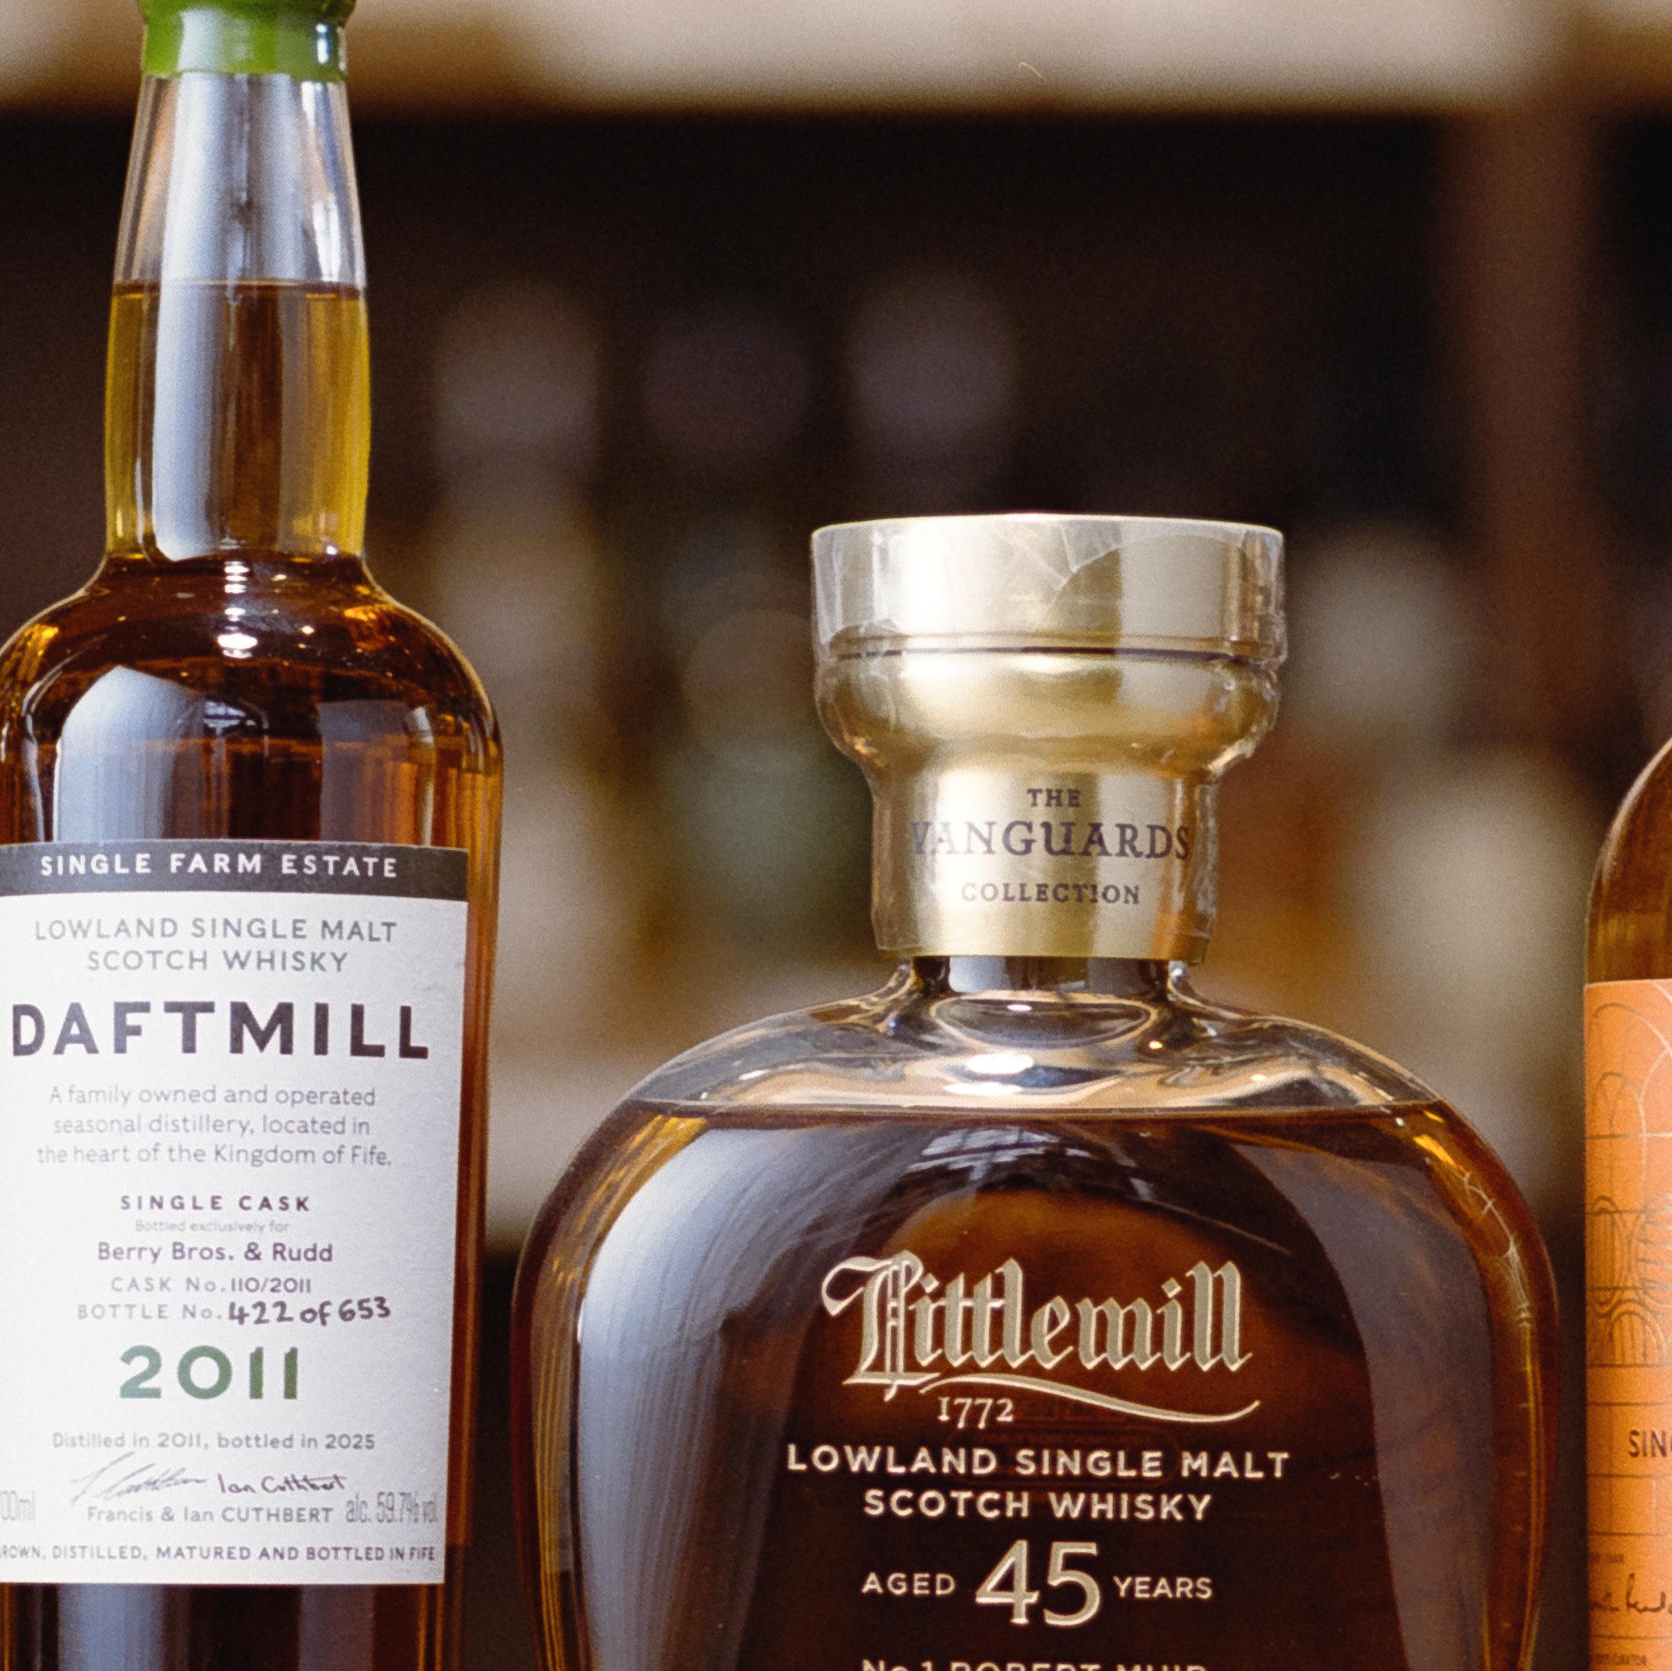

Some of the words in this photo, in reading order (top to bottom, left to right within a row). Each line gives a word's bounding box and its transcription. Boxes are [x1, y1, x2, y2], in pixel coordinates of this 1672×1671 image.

[1027, 788, 1081, 808] THE
[909, 821, 1190, 860] VANGUARDS
[41, 854, 151, 876] SINGLE
[171, 854, 261, 874] FARM
[282, 855, 397, 877] ESTATE
[962, 883, 1139, 905] COLLECTION
[35, 918, 178, 941] LOWLAND
[191, 918, 306, 939] SINGLE
[320, 921, 397, 942] MALT
[88, 951, 207, 971] SCOTCH
[223, 951, 348, 972] WHISKY
[12, 1001, 429, 1059] DAFTMILL
[49, 1086, 62, 1104] A
[67, 1085, 131, 1108] family
[138, 1085, 217, 1104] owned
[224, 1085, 268, 1104] and
[275, 1087, 376, 1111] operated
[54, 1116, 144, 1135] seasonal
[148, 1115, 255, 1139] distillery,
[262, 1116, 346, 1135] located
[352, 1117, 370, 1135] in
[38, 1146, 69, 1164] the
[73, 1145, 131, 1164] heart
[137, 1144, 161, 1162] of
[165, 1144, 207, 1162] the
[213, 1144, 316, 1168] Kingdom
[322, 1145, 346, 1164] of
[351, 1146, 392, 1166] Fife.
[120, 1195, 223, 1211] SINGLE
[239, 1195, 311, 1212] CASK
[98, 1242, 161, 1263] Berry
[172, 1242, 234, 1262] Bros.
[244, 1243, 262, 1262] &
[272, 1243, 333, 1263] Rudd
[111, 1277, 173, 1293] CASK
[185, 1277, 226, 1293] No.
[230, 1277, 311, 1294] 110/2011
[77, 1304, 169, 1320] BOTTLE
[182, 1304, 222, 1320] No.
[228, 1300, 293, 1325] 422
[299, 1302, 333, 1326] of
[338, 1296, 391, 1322] 653
[821, 1250, 1253, 1401] Littlemill
[119, 1345, 299, 1400] 2011
[937, 1397, 1015, 1428] 1772
[53, 1433, 126, 1450] Distilled
[132, 1432, 150, 1449] in
[158, 1432, 209, 1451] 2011,
[217, 1432, 293, 1450] bottled
[300, 1433, 319, 1450] in
[787, 1444, 997, 1474] LOWLAND
[1015, 1449, 1163, 1478] SINGLE
[1181, 1451, 1289, 1479] MALT
[87, 1506, 154, 1523] Francis
[161, 1506, 176, 1523] &
[184, 1506, 215, 1523] Ian
[221, 1506, 334, 1524] CUTHBERT
[864, 1490, 1030, 1517] SCOTCH
[1048, 1493, 1212, 1520] WHISKY
[52, 1546, 148, 1561] DISTILLED,
[156, 1546, 252, 1560] MATURED
[258, 1546, 299, 1561] AND
[306, 1546, 385, 1561] BOTTLED
[389, 1547, 405, 1561] IN
[409, 1547, 436, 1561] FIFE
[861, 1572, 956, 1596] AGED
[975, 1539, 1101, 1626] 45
[1113, 1576, 1213, 1599] YEARS
